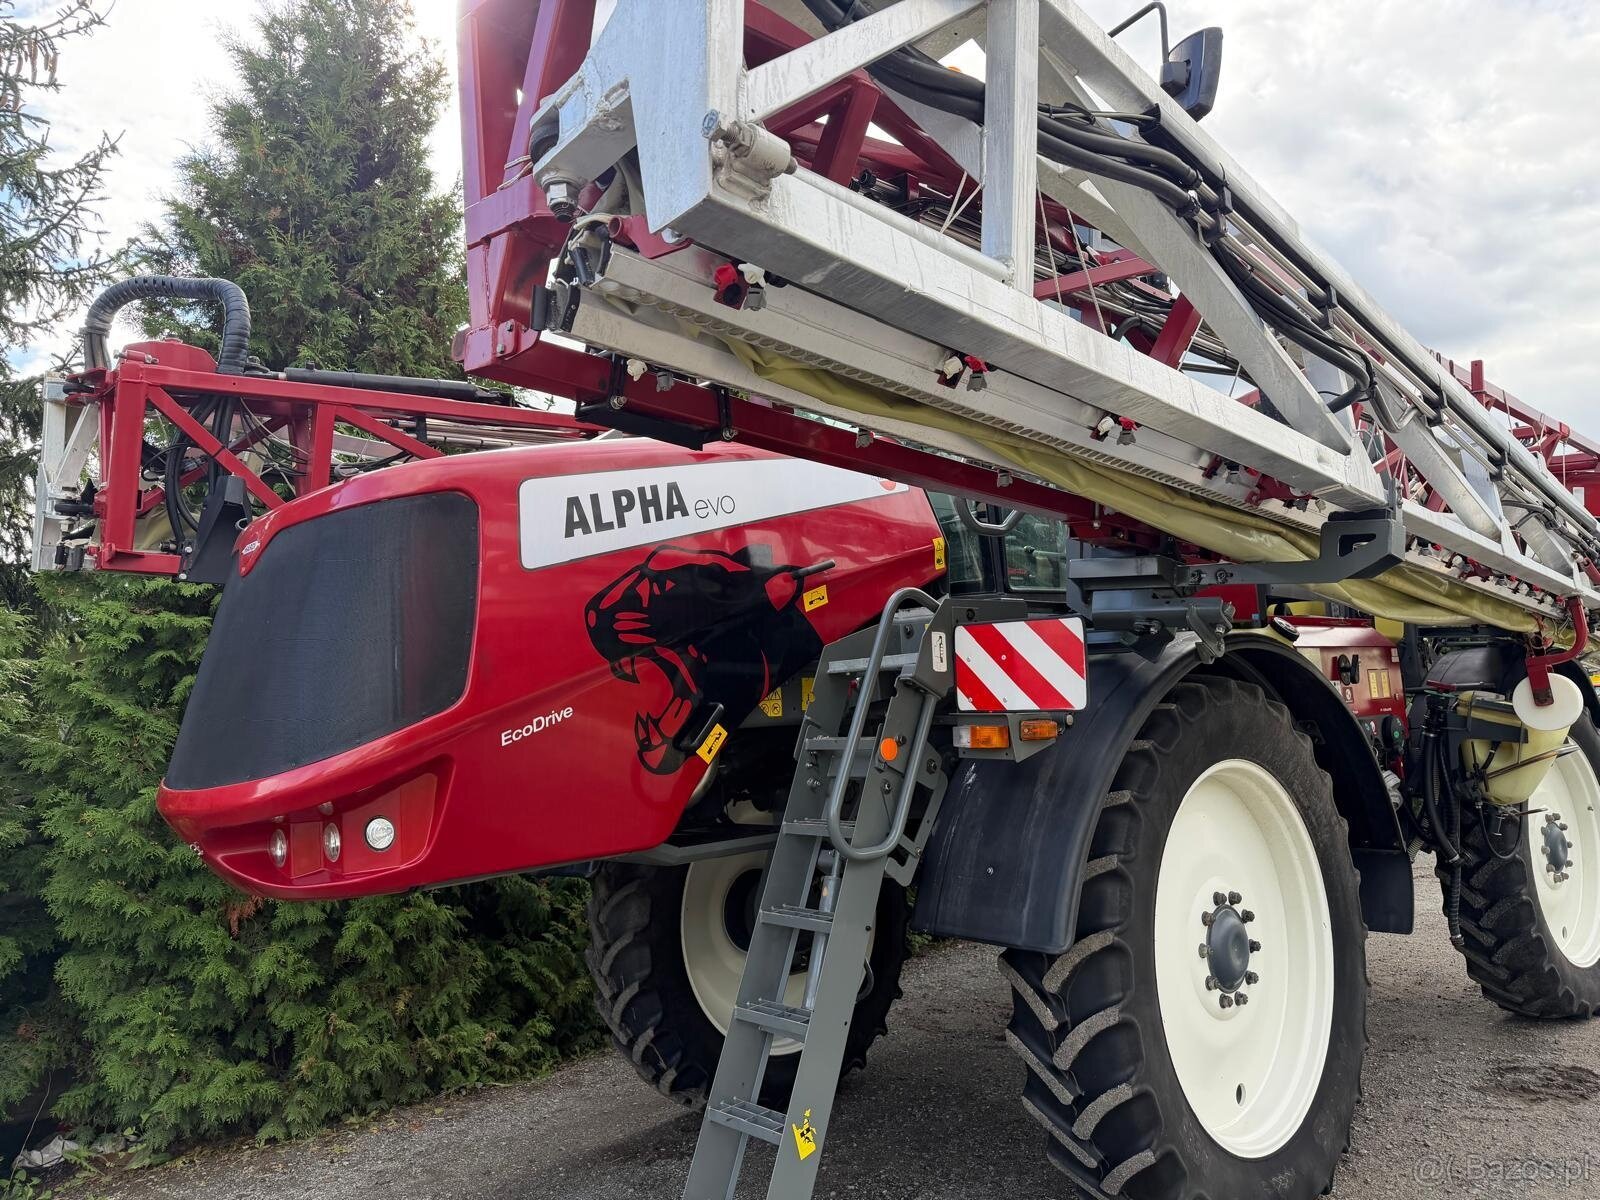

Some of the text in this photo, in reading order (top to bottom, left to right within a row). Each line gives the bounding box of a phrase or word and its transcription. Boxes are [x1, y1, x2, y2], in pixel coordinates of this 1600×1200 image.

[564, 481, 736, 539] ALPHA evo
[501, 706, 574, 747] EcoDrive
